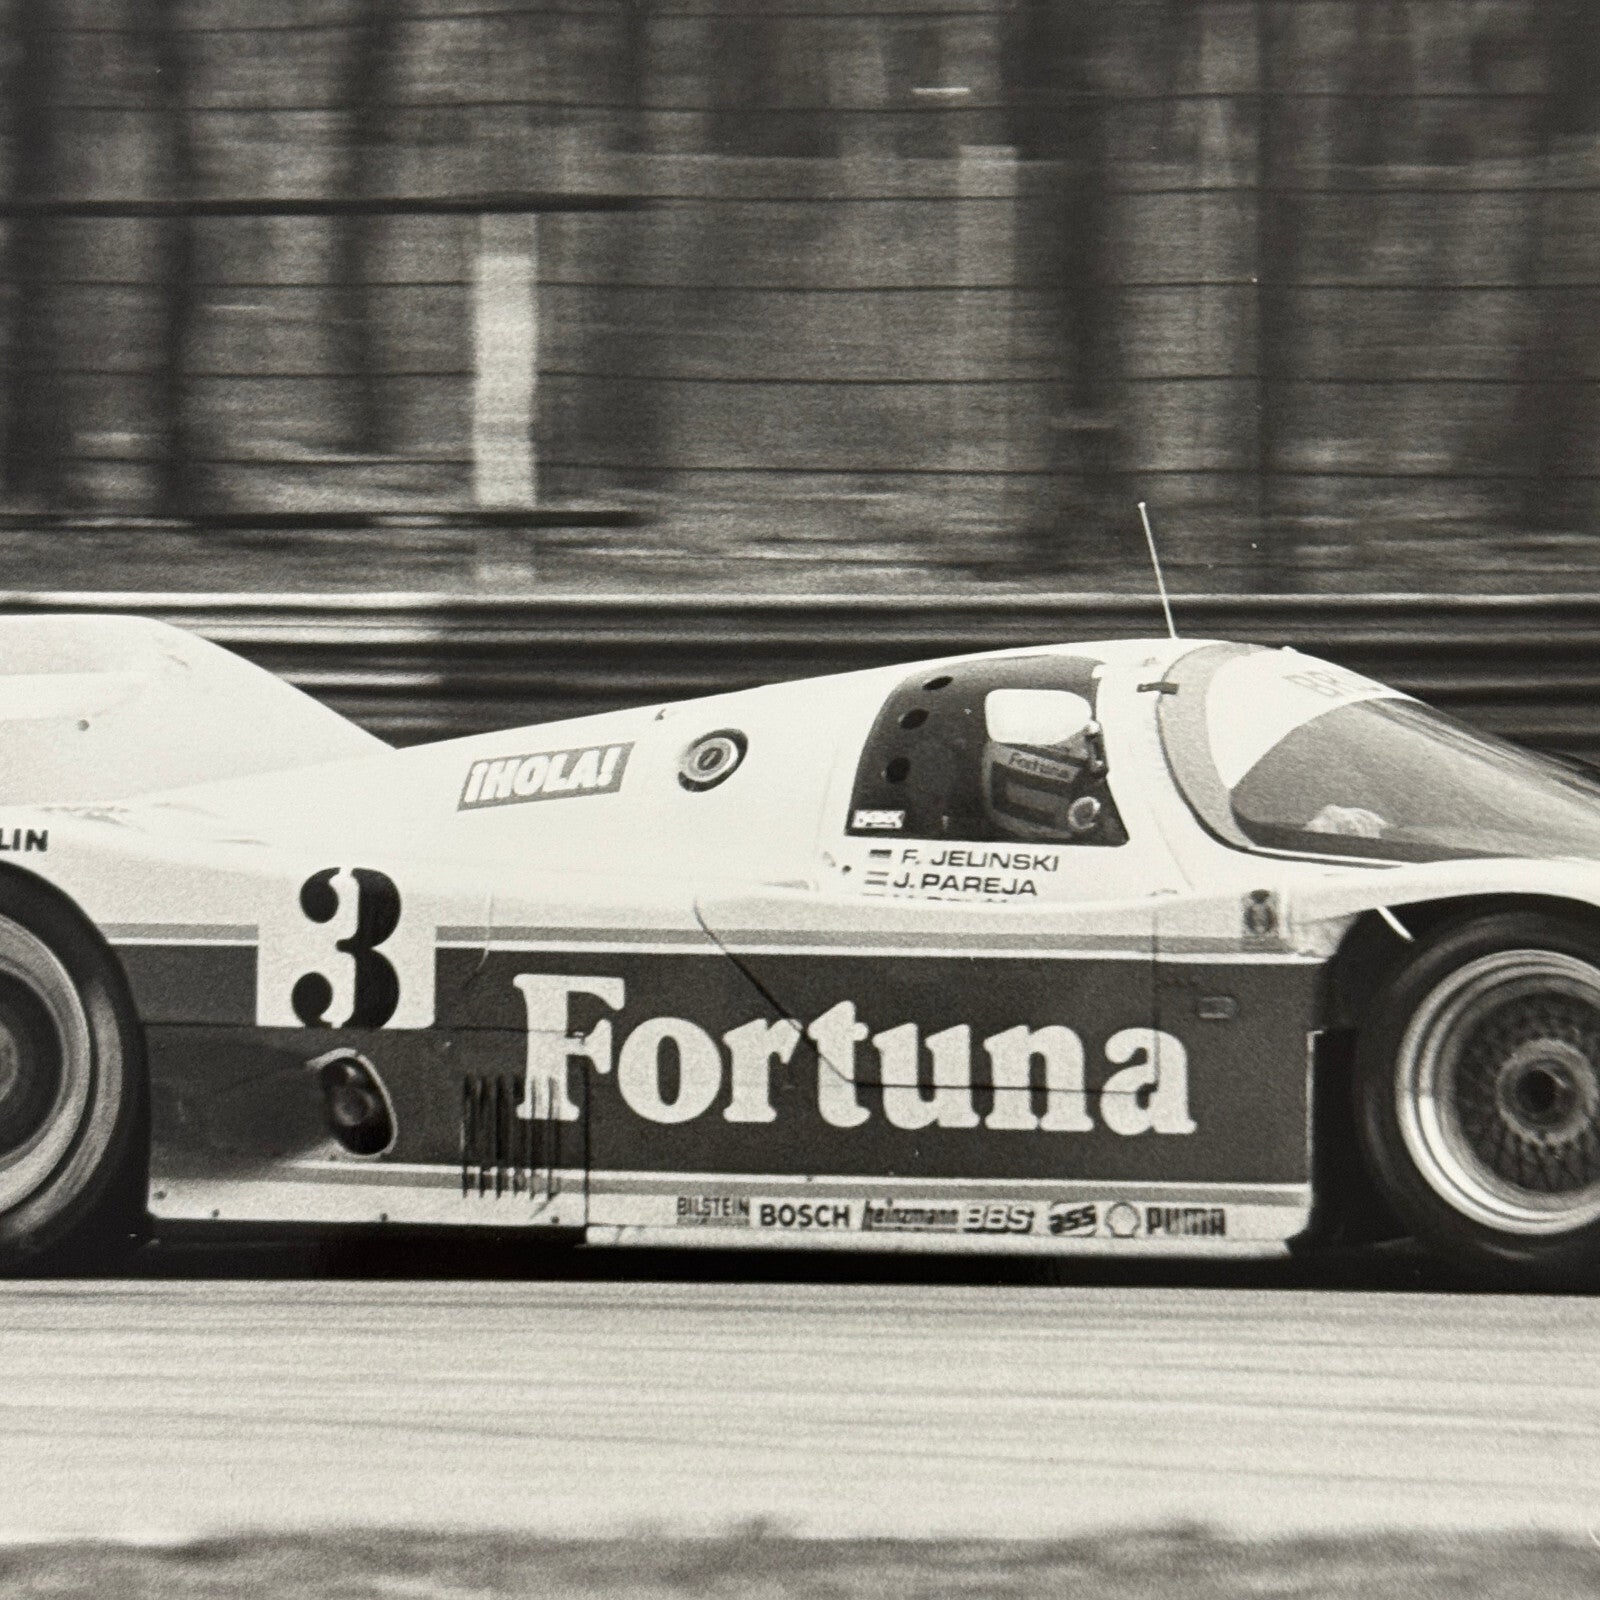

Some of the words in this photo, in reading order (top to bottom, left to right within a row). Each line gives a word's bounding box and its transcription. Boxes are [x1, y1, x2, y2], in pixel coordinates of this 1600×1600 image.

[902, 849, 920, 865] F.
[931, 850, 1060, 872] JELINSKI
[893, 872, 915, 889] J.
[920, 873, 1037, 896] PAREJA
[291, 867, 402, 1029] 3
[513, 973, 1197, 1135] Fortuna
[760, 1203, 850, 1228] BOSCH
[1146, 1207, 1226, 1236] PUMA
